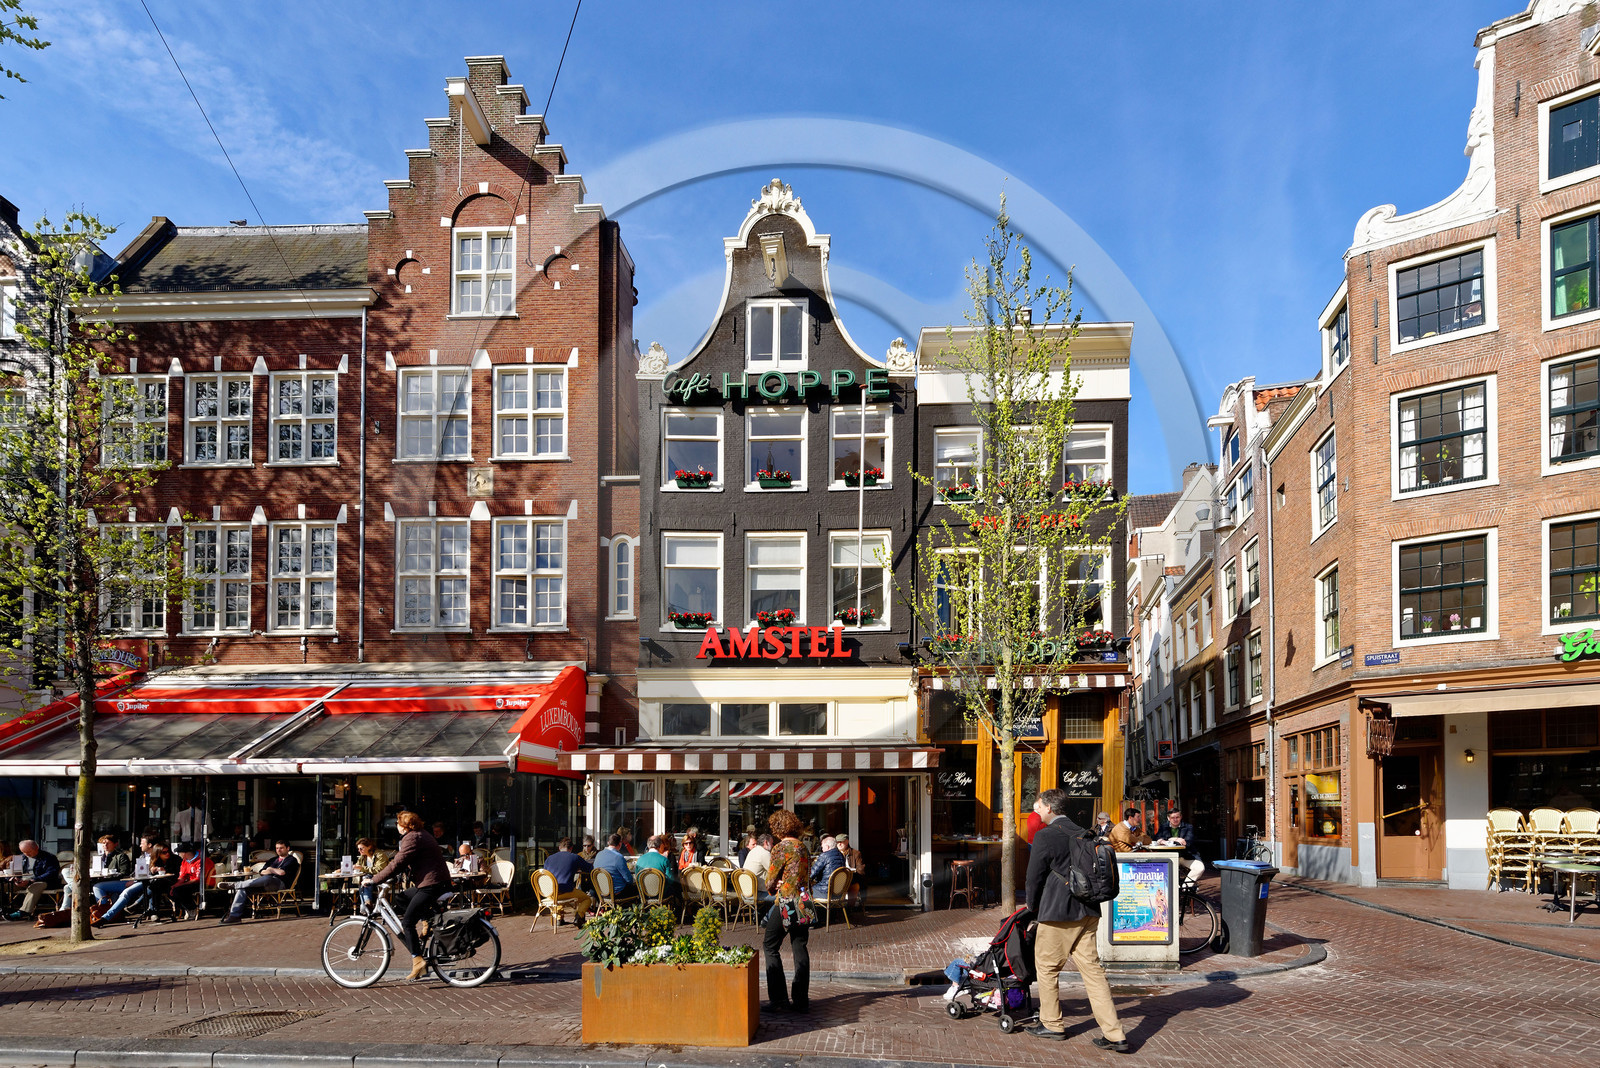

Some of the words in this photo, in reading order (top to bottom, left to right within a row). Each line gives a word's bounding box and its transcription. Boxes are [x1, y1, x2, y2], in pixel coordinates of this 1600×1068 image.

[662, 370, 711, 401] Café
[722, 368, 890, 399] HOPPE
[695, 626, 852, 659] AMSTEL
[1366, 653, 1398, 661] SPUISTRAAT
[1560, 628, 1600, 661] Gr
[125, 703, 150, 711] Jupiler
[504, 699, 530, 708] Jupiler
[540, 707, 582, 742] LUXEMBOURG
